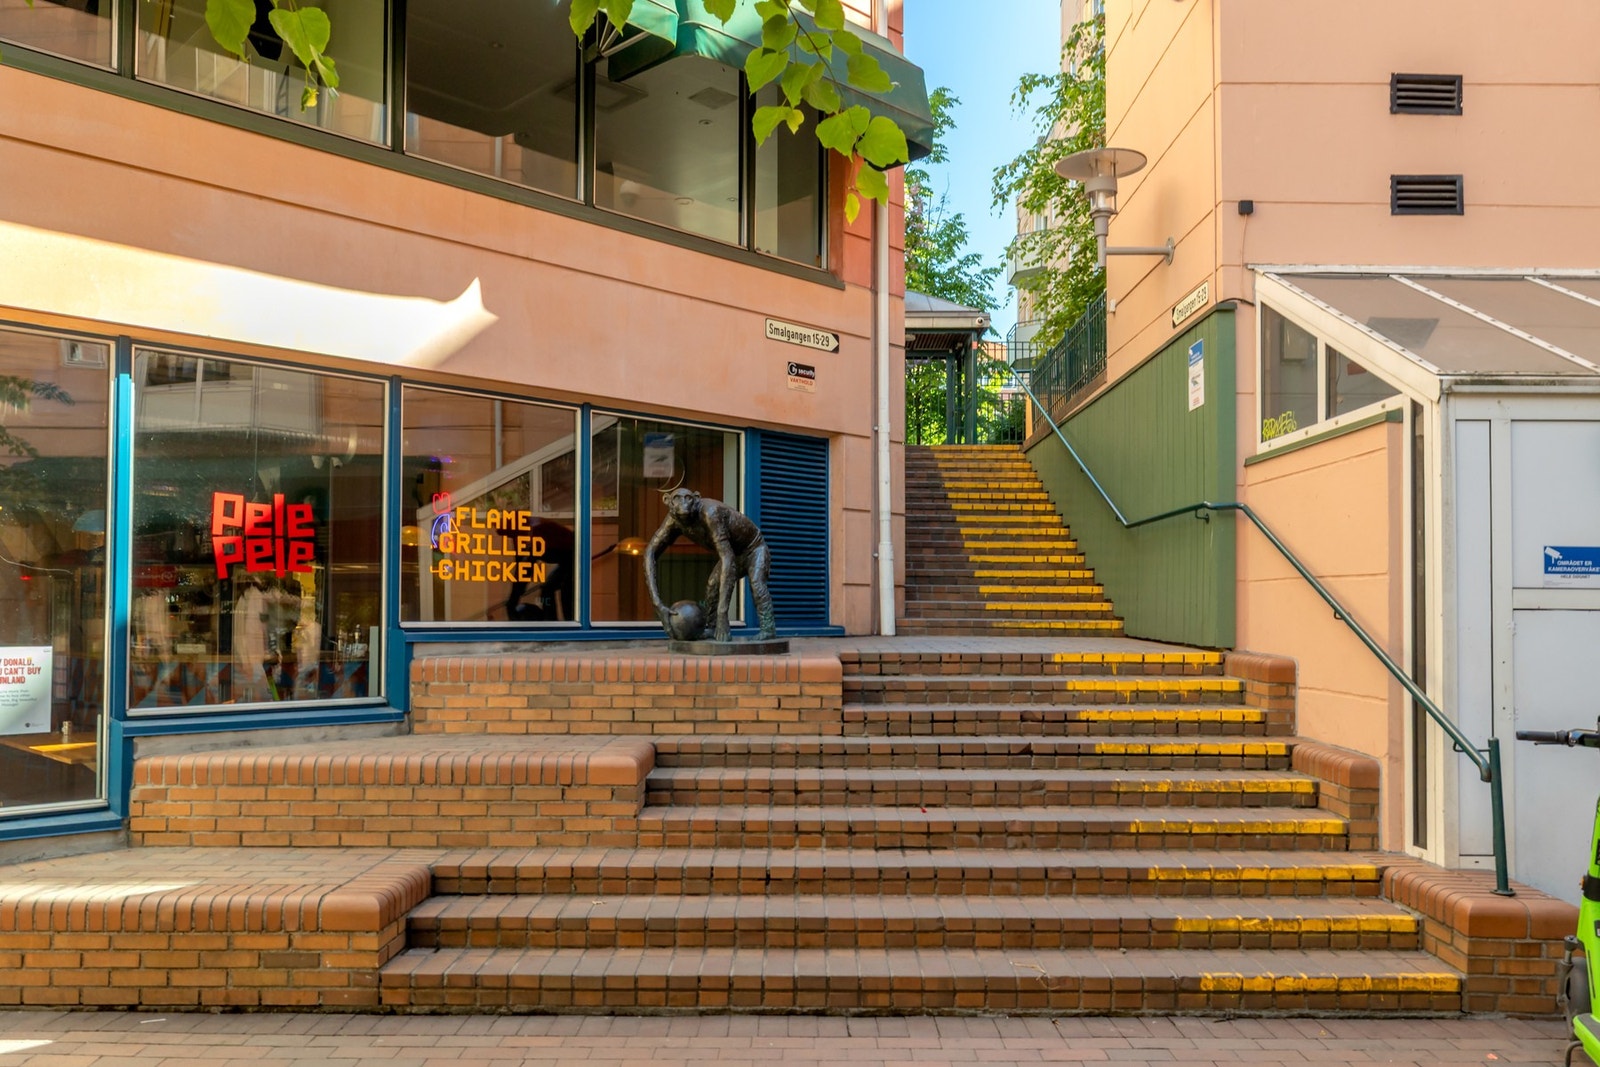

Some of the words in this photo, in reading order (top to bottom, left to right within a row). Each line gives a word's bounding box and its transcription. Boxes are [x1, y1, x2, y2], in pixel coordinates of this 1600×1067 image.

[768, 323, 812, 344] Smalgangen
[812, 333, 830, 347] 15-29
[789, 376, 814, 386] VAKTHOLD
[455, 506, 532, 531] FLAME
[439, 532, 546, 557] GRILLED
[438, 559, 546, 583] CHICKEN
[27, 667, 41, 675] BUY
